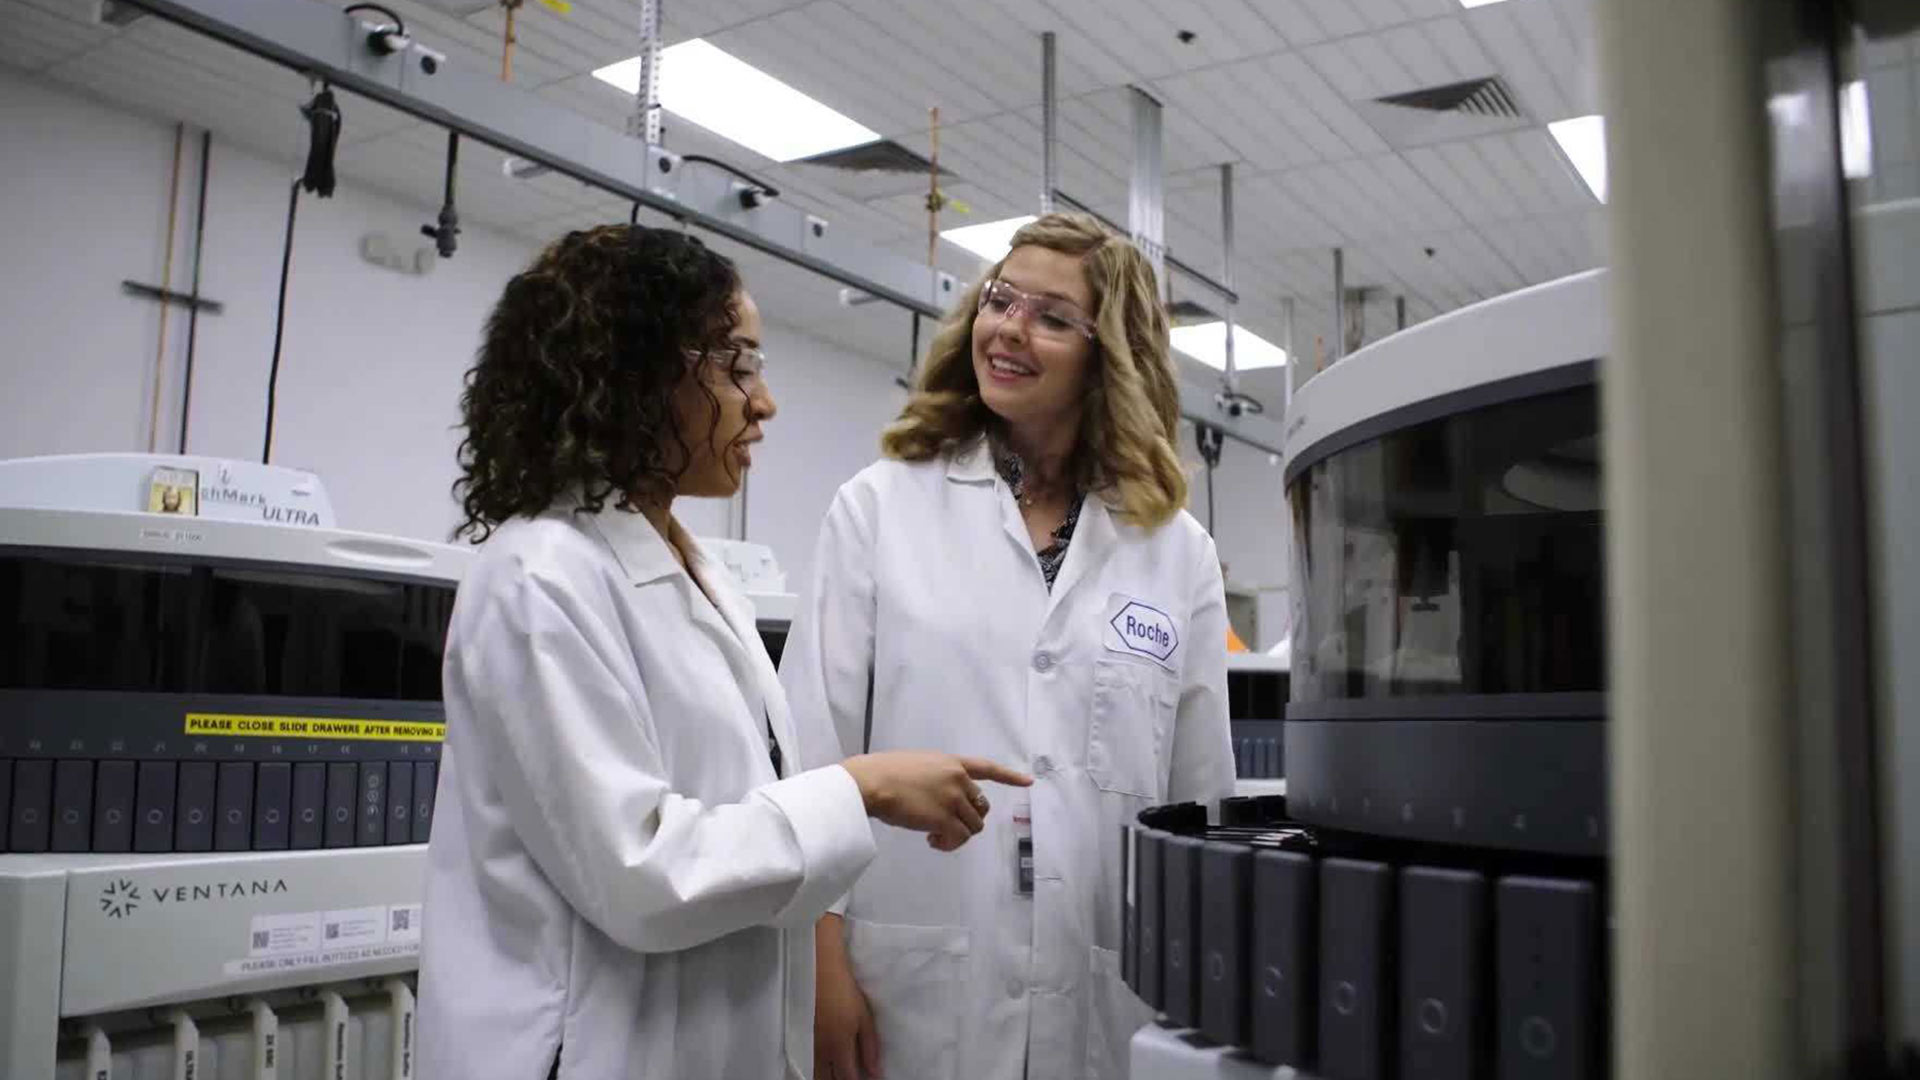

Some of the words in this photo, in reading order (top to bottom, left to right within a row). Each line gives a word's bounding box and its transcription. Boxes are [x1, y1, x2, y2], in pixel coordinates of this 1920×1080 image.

[262, 506, 319, 526] ULTRA
[1126, 614, 1169, 647] Roche
[189, 719, 231, 730] PLEASE
[237, 721, 273, 731] CLOSE
[279, 722, 307, 732] SLIDE
[313, 723, 359, 734] DRAWERS
[364, 725, 390, 735] AFTER
[393, 727, 433, 736] REMOVING
[153, 879, 288, 903] VENTANA
